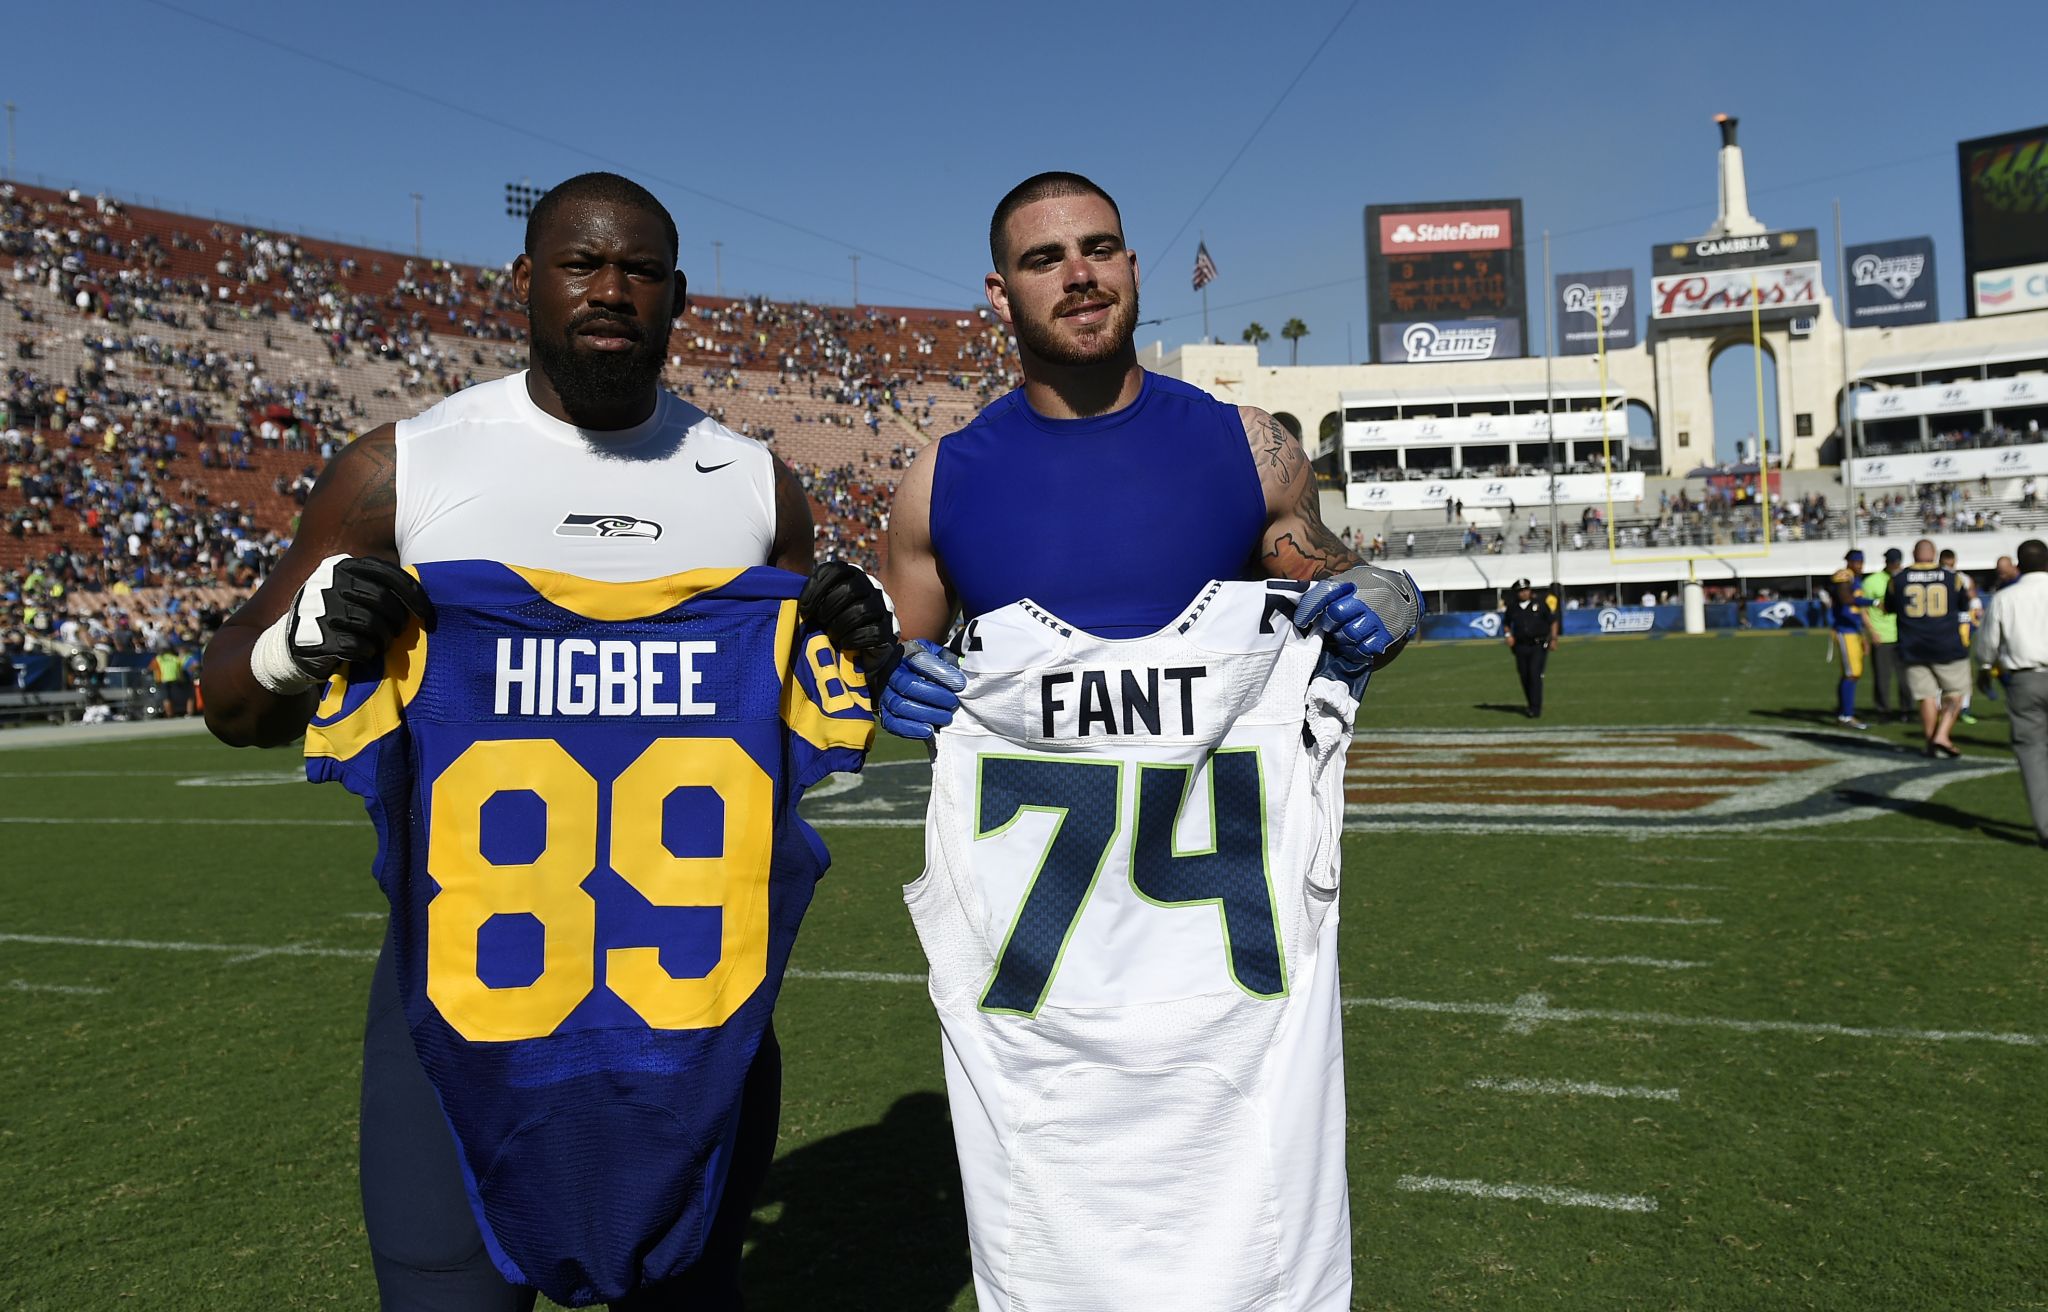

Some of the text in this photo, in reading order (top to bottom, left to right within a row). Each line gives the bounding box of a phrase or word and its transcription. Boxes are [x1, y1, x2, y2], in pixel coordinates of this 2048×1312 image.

[1696, 236, 1770, 257] CAMBRIA
[1403, 322, 1496, 362] Rams
[1904, 582, 1948, 618] 30
[494, 638, 717, 717] HIGBEE
[1041, 666, 1207, 738] FANT
[426, 737, 774, 1042] 89
[973, 746, 1290, 1020] 74
